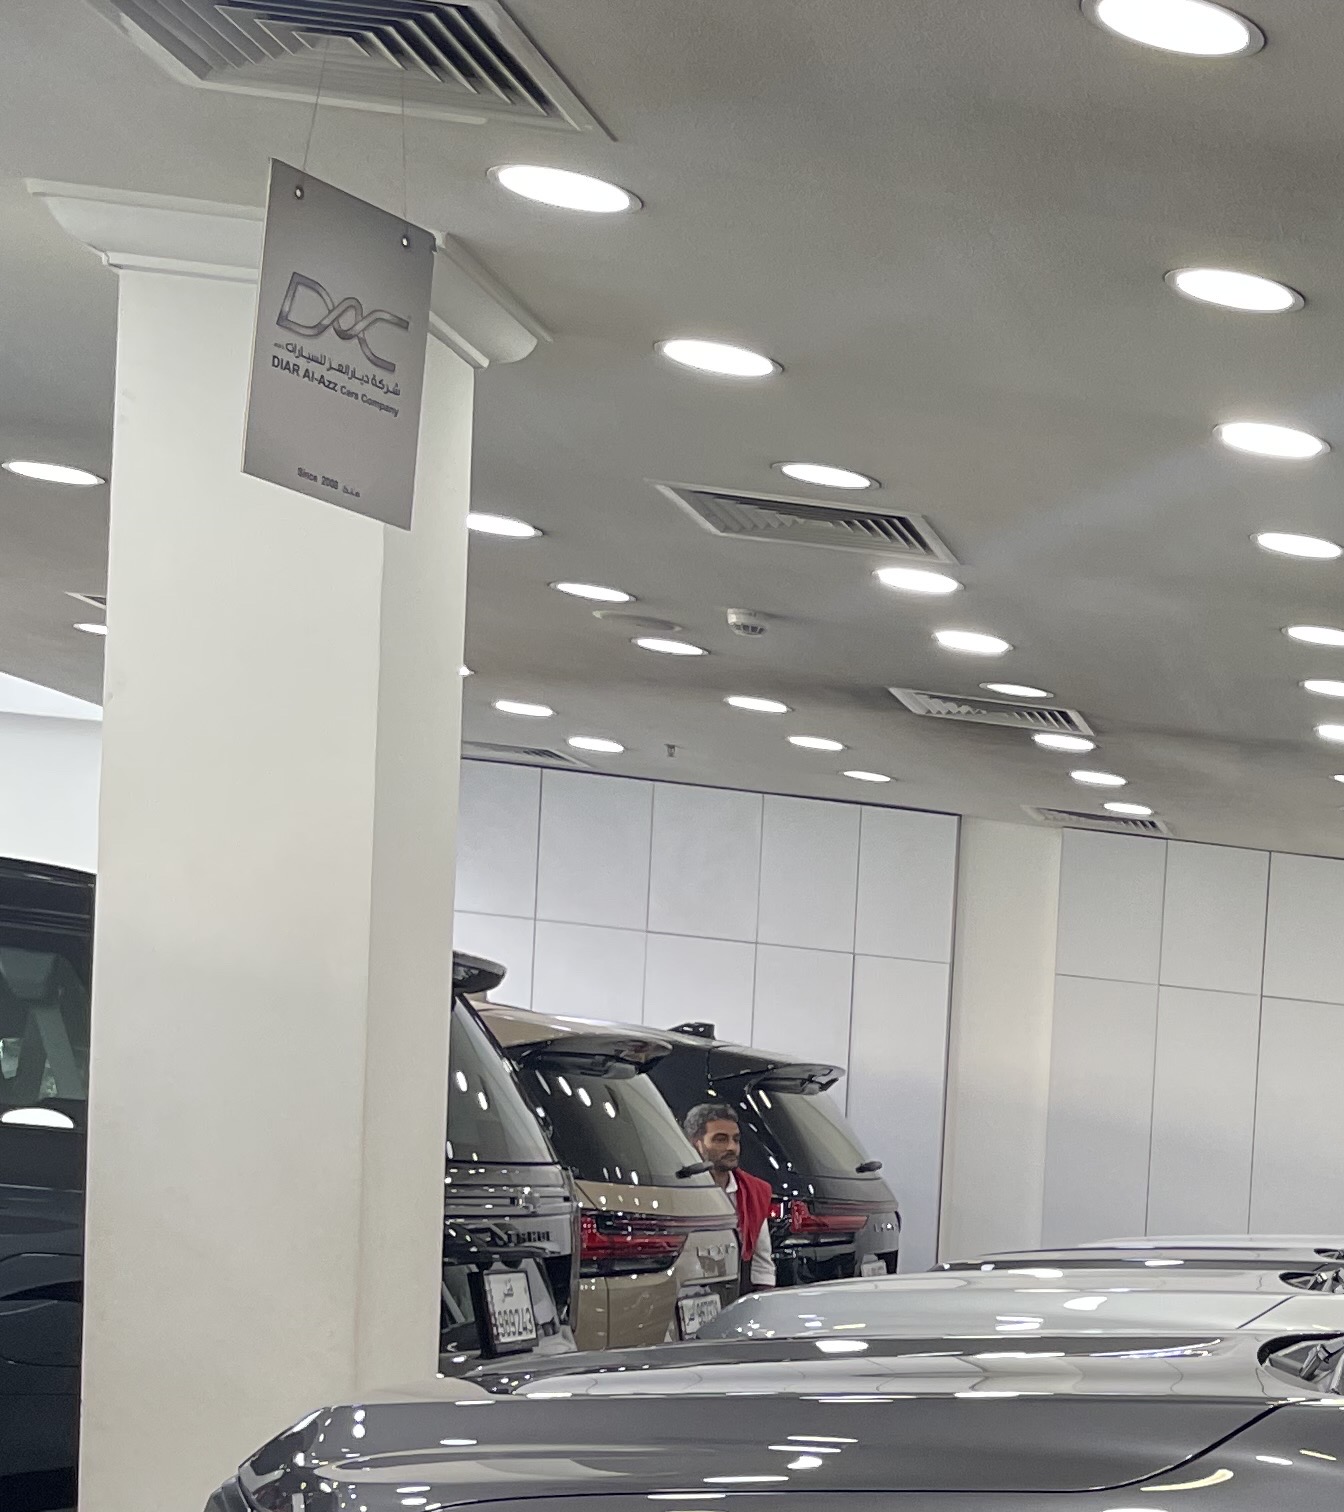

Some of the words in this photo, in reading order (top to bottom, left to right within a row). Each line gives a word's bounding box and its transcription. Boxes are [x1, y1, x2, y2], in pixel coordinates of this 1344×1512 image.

[271, 355, 300, 377] DIAR
[302, 368, 338, 392] Al-Azz
[361, 393, 400, 418] Company
[371, 374, 400, 396] شركة
